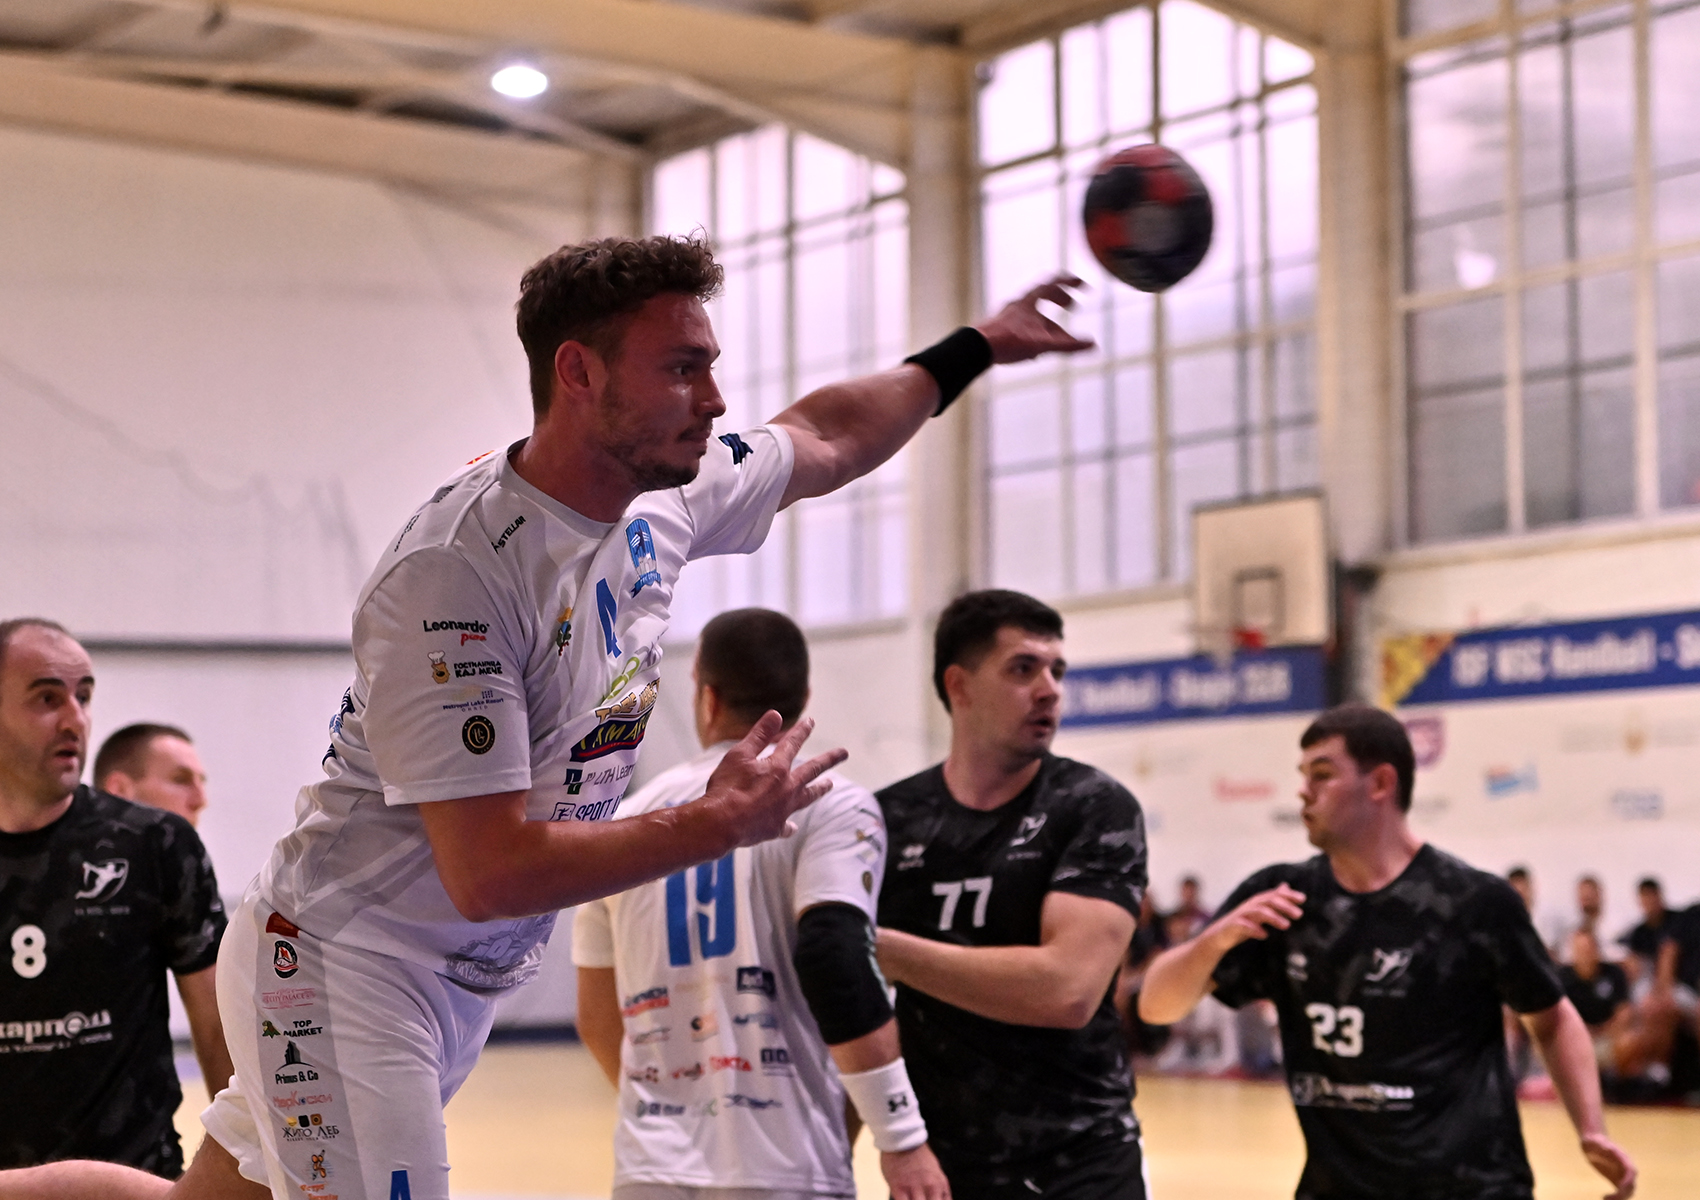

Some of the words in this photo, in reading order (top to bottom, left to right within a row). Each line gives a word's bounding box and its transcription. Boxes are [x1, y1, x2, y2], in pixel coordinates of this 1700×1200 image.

[423, 620, 488, 634] Leonardo
[666, 850, 736, 967] 19
[932, 876, 993, 931] 77
[11, 924, 47, 979] 8
[293, 1020, 312, 1028] TOP
[1305, 1003, 1365, 1058] 23
[284, 1027, 323, 1037] MARKET
[275, 1073, 298, 1084] Primus
[299, 1071, 306, 1081] &
[307, 1070, 319, 1081] Co
[282, 1127, 312, 1138] ЖИТО
[318, 1125, 339, 1138] ЛЕБ
